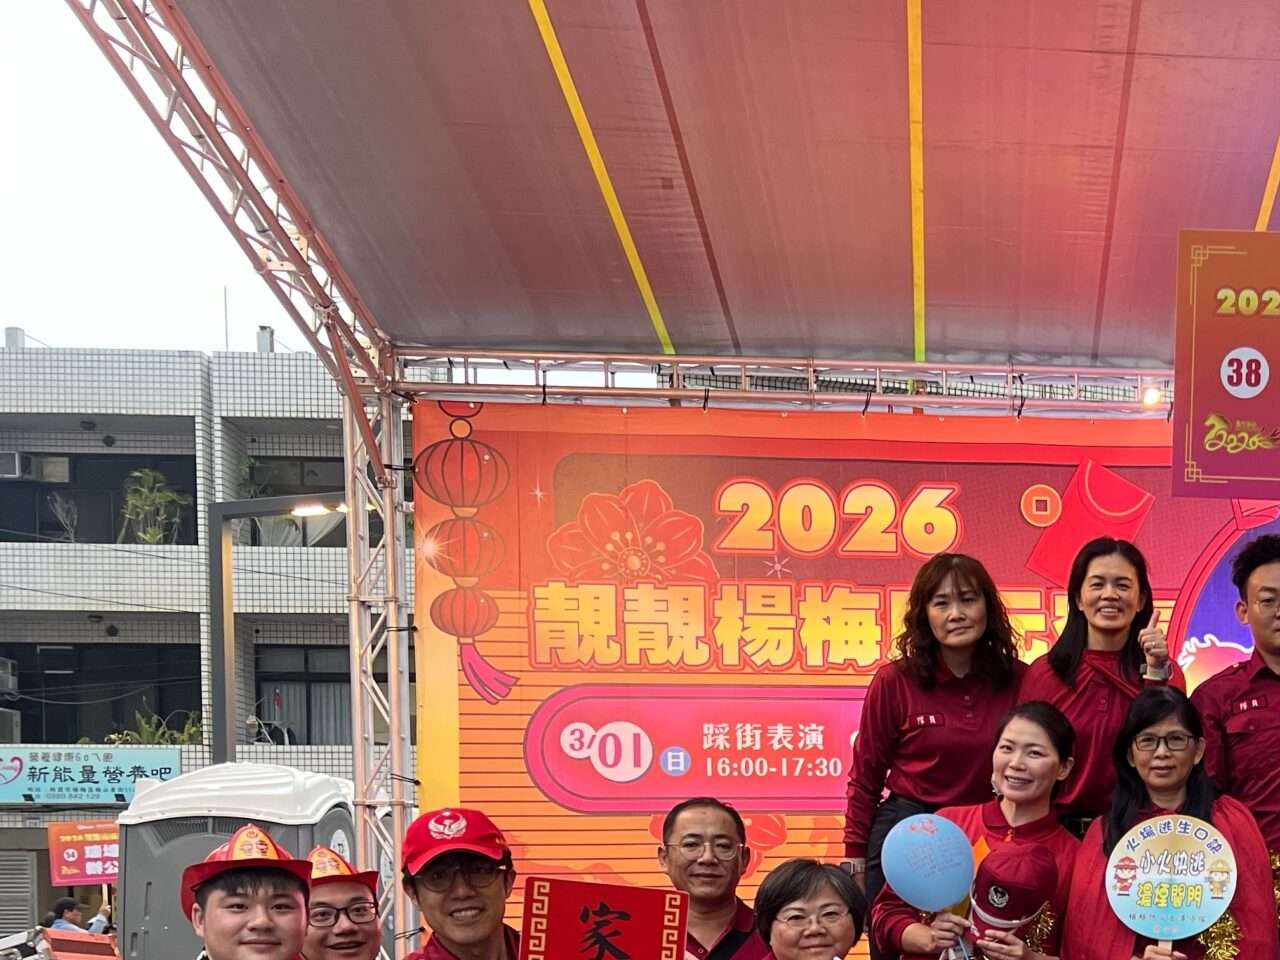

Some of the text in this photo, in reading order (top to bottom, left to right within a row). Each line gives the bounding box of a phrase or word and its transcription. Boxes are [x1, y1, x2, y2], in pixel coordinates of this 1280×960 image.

[1226, 358, 1261, 388] 38
[718, 481, 958, 555] 2026
[702, 723, 825, 751] 踩街表演
[27, 764, 173, 785] 新能量營養吧
[704, 757, 842, 777] 16:00-17:30
[1141, 849, 1205, 876] 小火快逃
